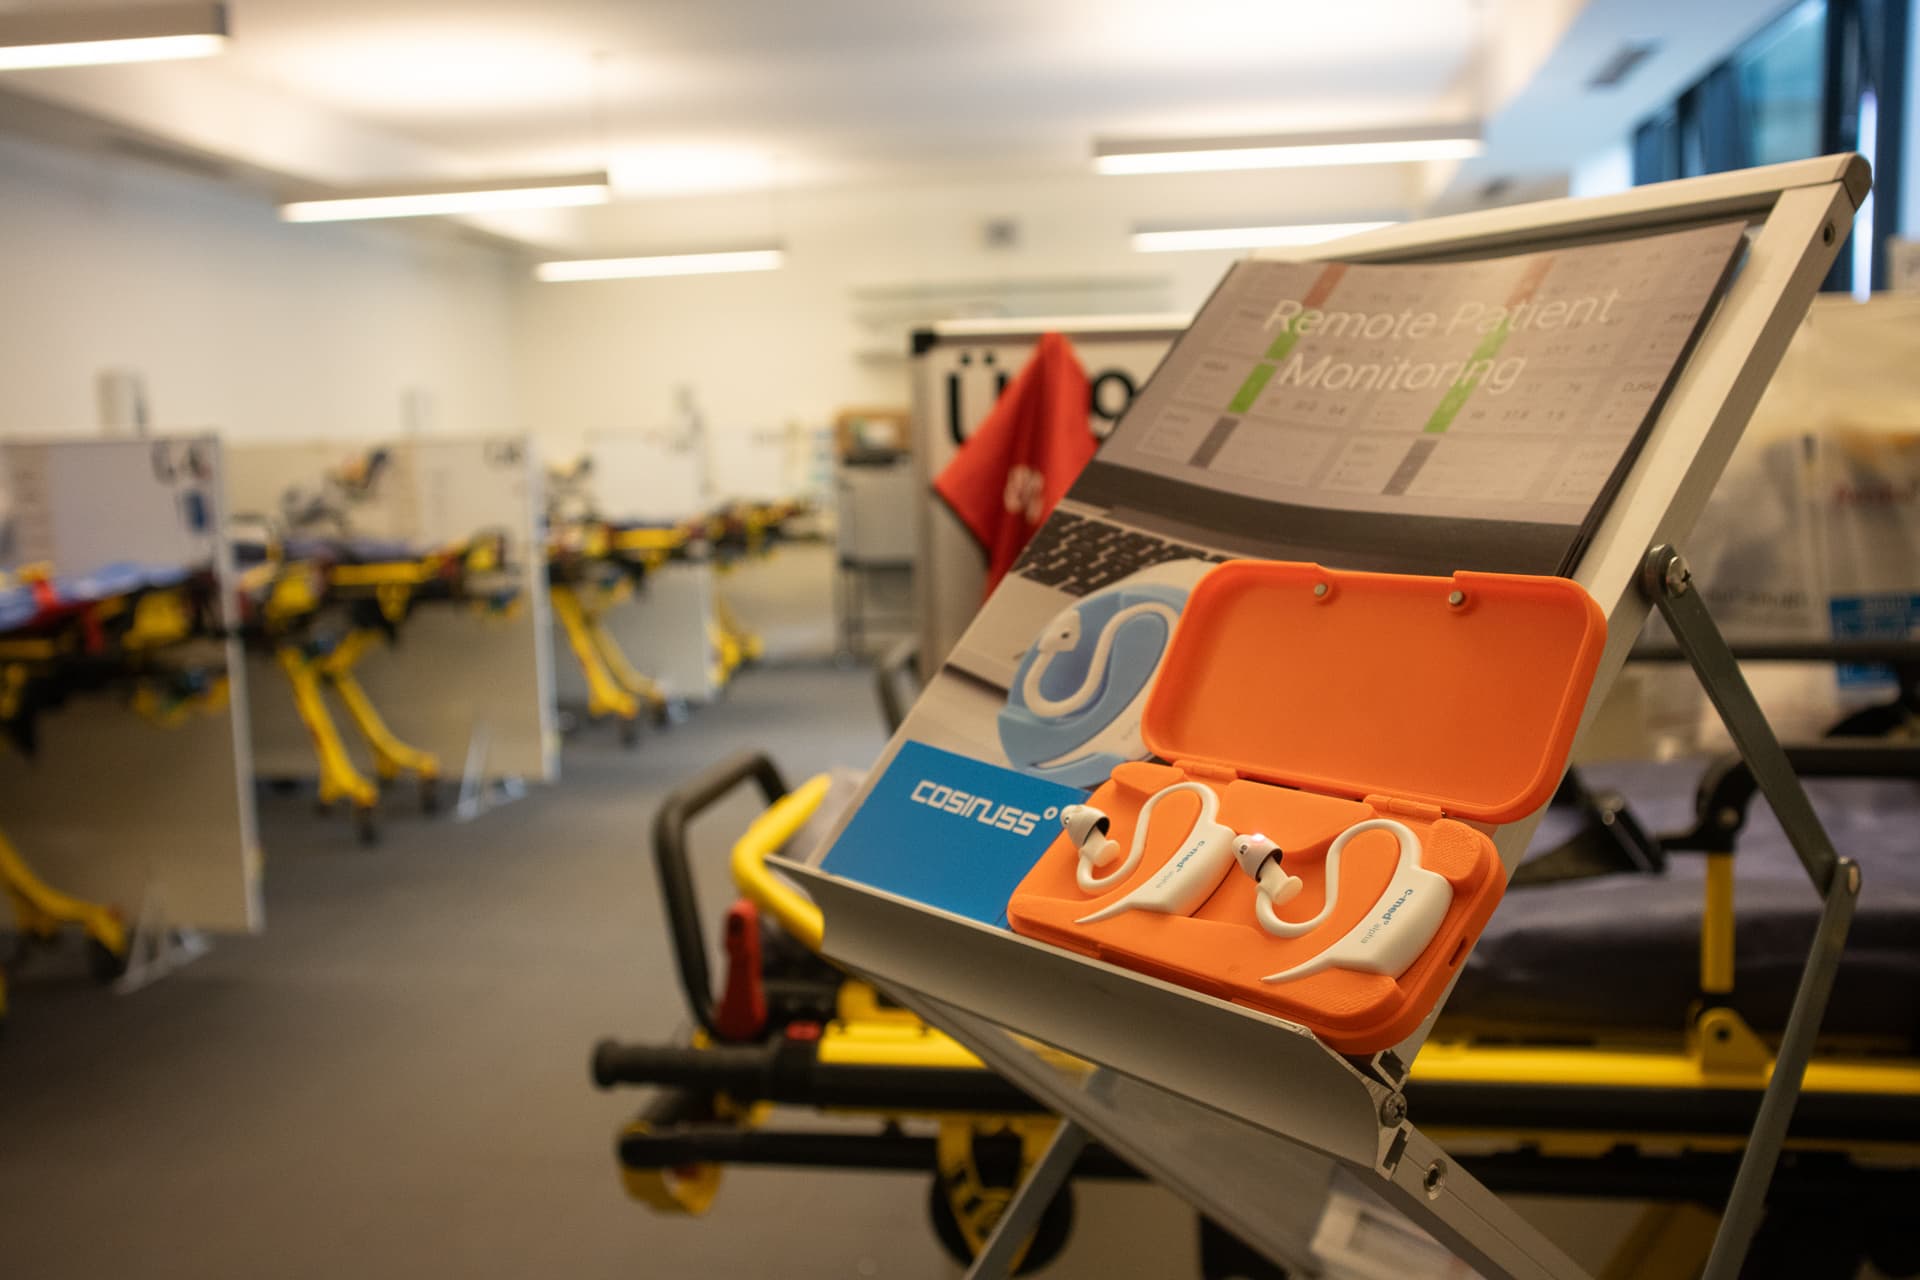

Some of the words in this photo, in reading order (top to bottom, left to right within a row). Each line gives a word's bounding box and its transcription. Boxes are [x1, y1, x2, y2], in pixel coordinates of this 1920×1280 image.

[1263, 298, 1438, 340] Remote
[1444, 287, 1621, 337] Patient
[1278, 351, 1528, 395] Monitoring
